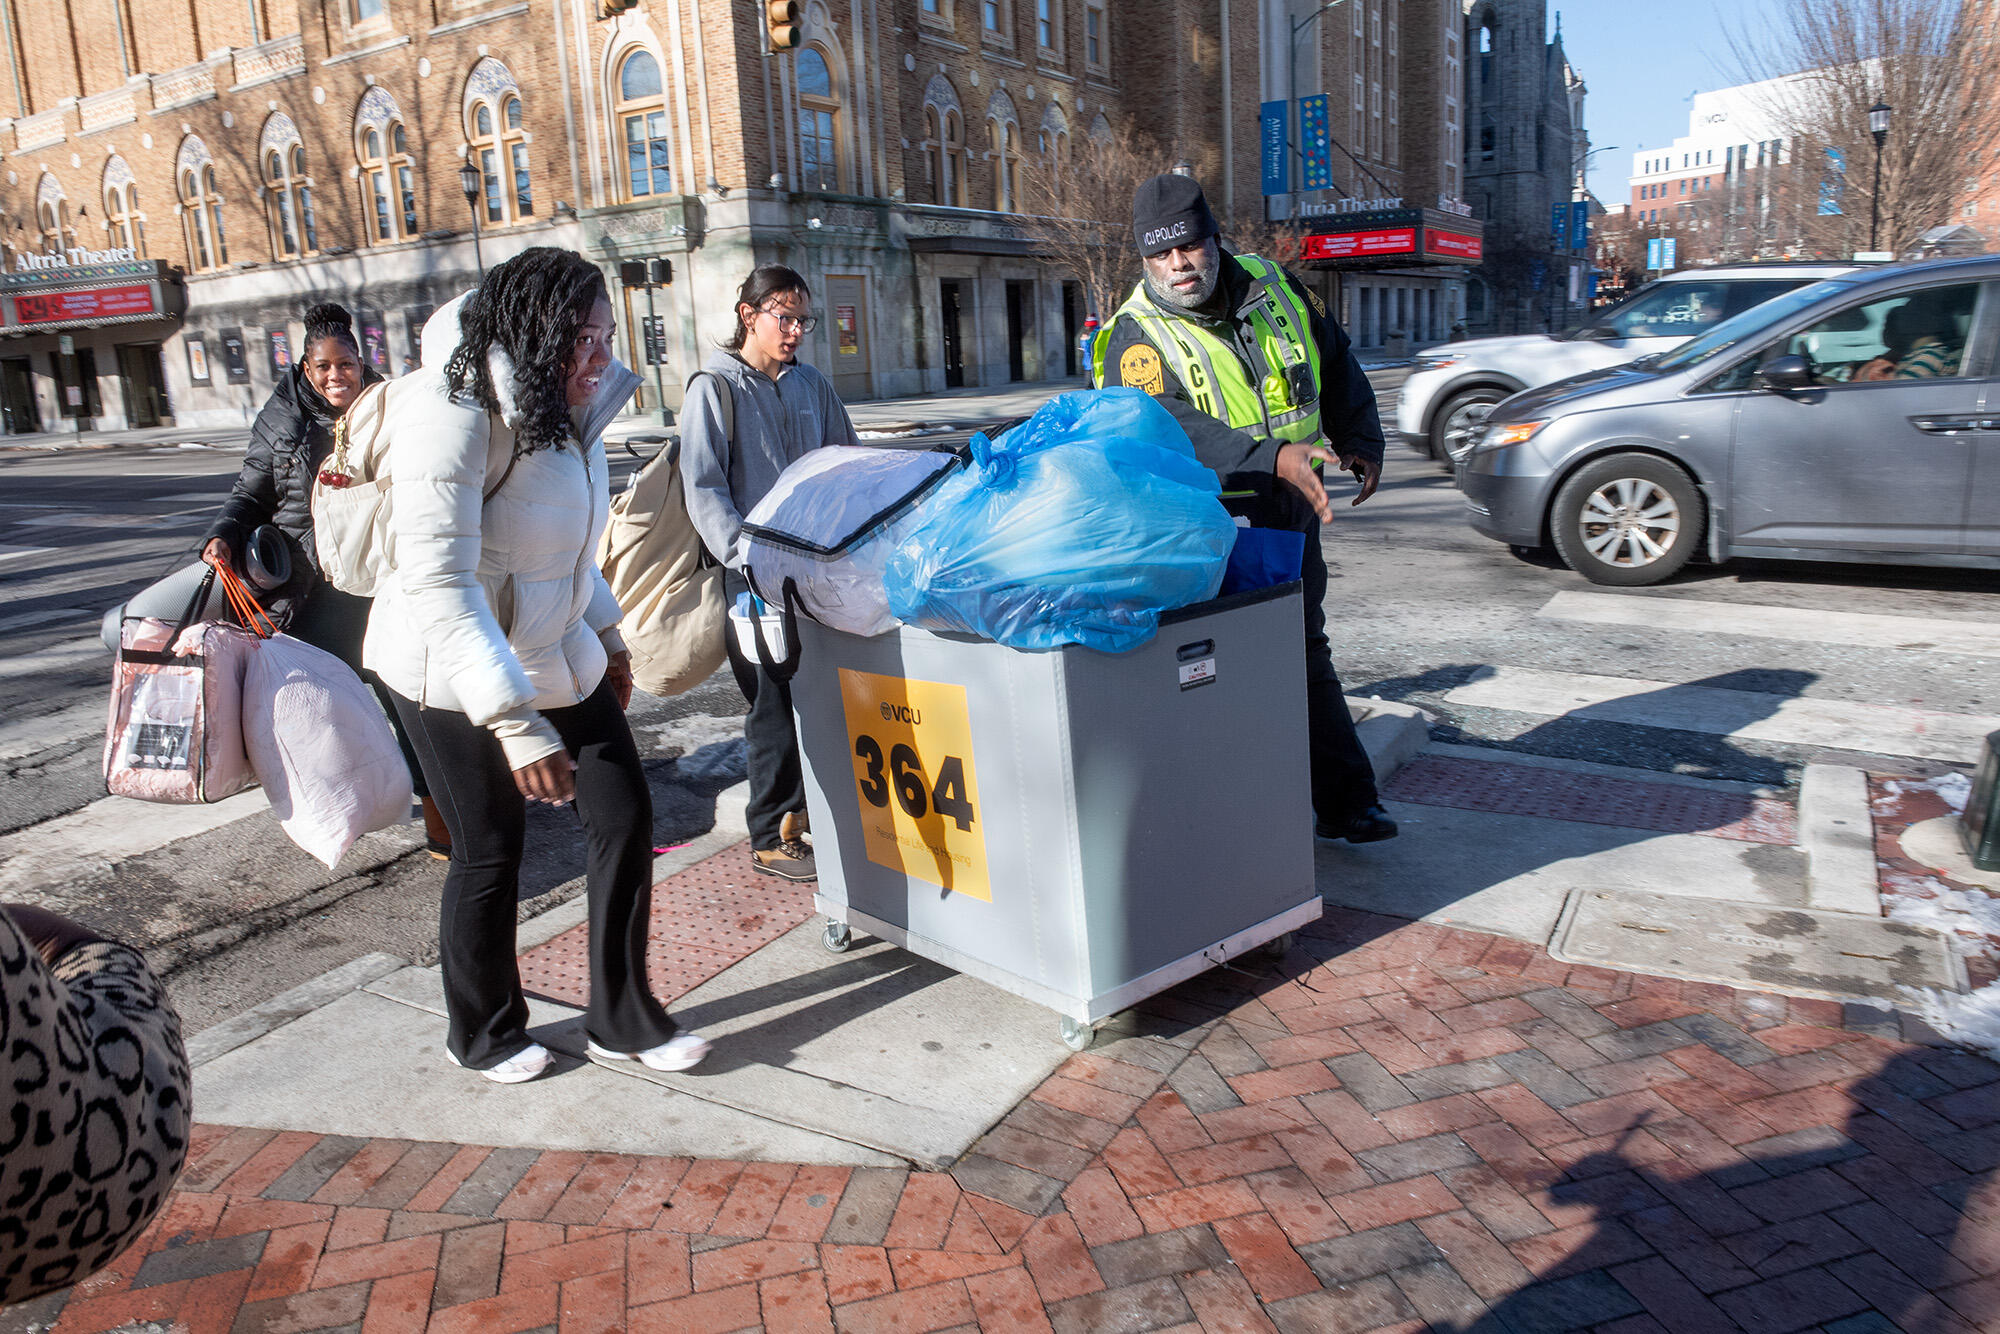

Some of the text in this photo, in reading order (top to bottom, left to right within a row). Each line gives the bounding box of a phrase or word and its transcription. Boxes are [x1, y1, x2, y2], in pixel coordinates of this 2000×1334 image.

[1300, 197, 1403, 217] ltria Theater
[1155, 221, 1187, 243] POLICE
[15, 246, 137, 271] Altria Theater
[1266, 300, 1303, 360] POLI
[890, 704, 921, 725] VCU
[855, 734, 975, 833] 364
